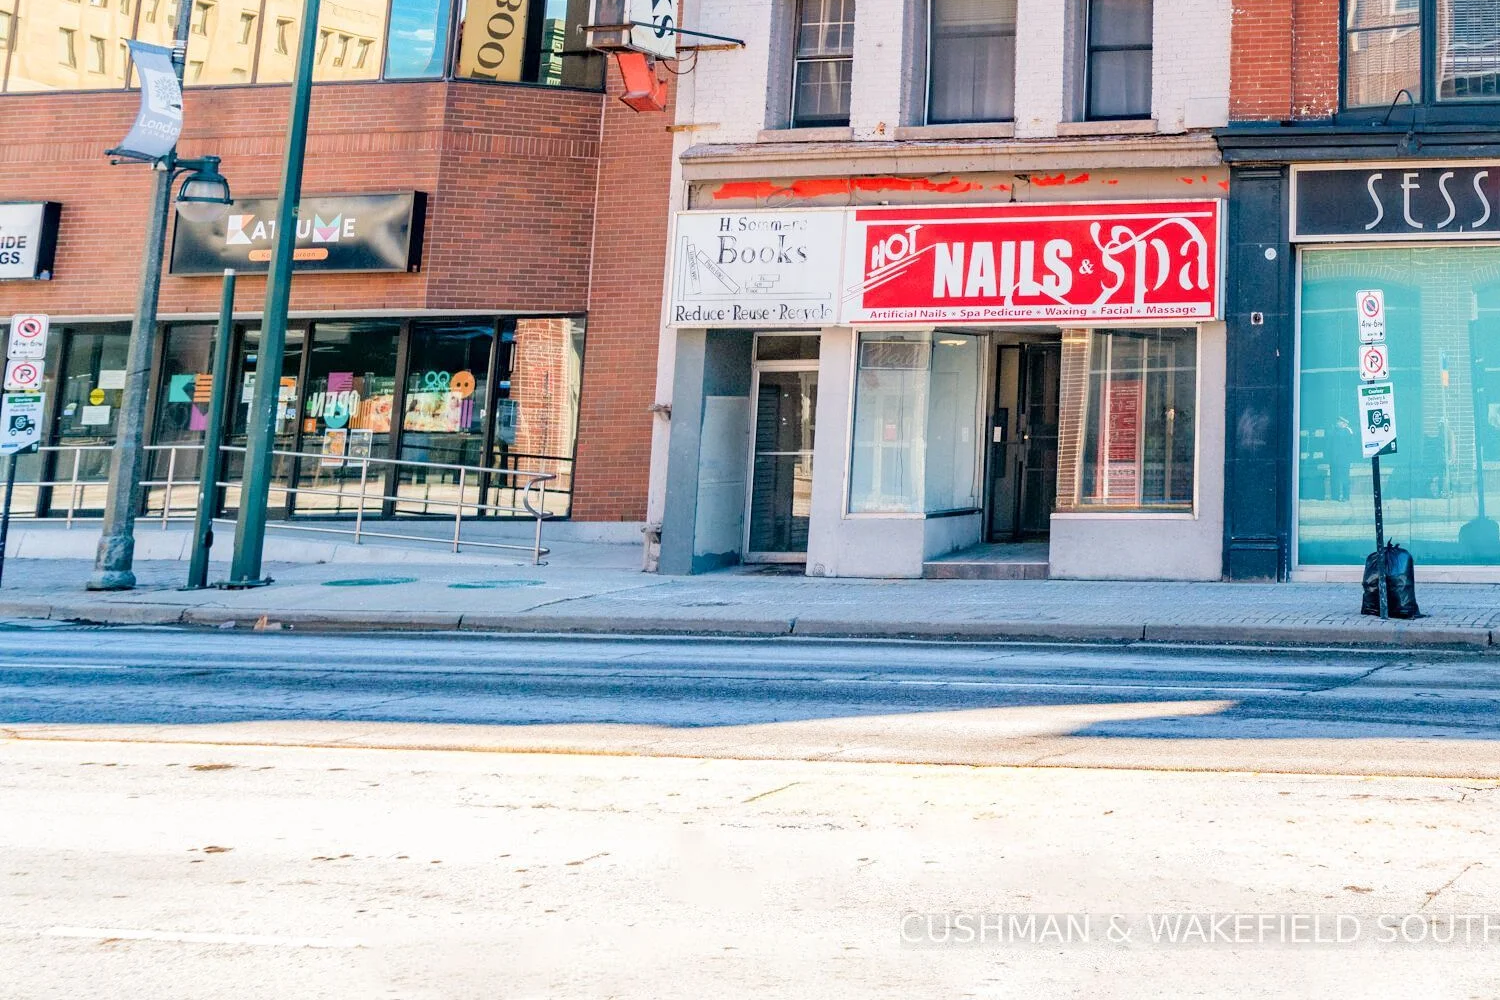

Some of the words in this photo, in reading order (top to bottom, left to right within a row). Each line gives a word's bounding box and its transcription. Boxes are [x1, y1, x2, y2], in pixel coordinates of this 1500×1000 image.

[139, 113, 181, 136] Londo
[226, 213, 356, 245] KATUME
[717, 234, 808, 265] Books
[871, 225, 922, 269] HOT
[932, 238, 1073, 305] NAILS
[1078, 258, 1094, 275] &
[675, 304, 726, 322] Reduce
[732, 304, 770, 321] Reuse
[869, 310, 917, 320] Artificial
[920, 309, 947, 318] Nails
[959, 309, 981, 320] Spa
[983, 307, 1033, 318] Pedicure
[1045, 307, 1087, 319] Waxing
[1100, 306, 1134, 316] Facial
[1146, 305, 1197, 317] Massage
